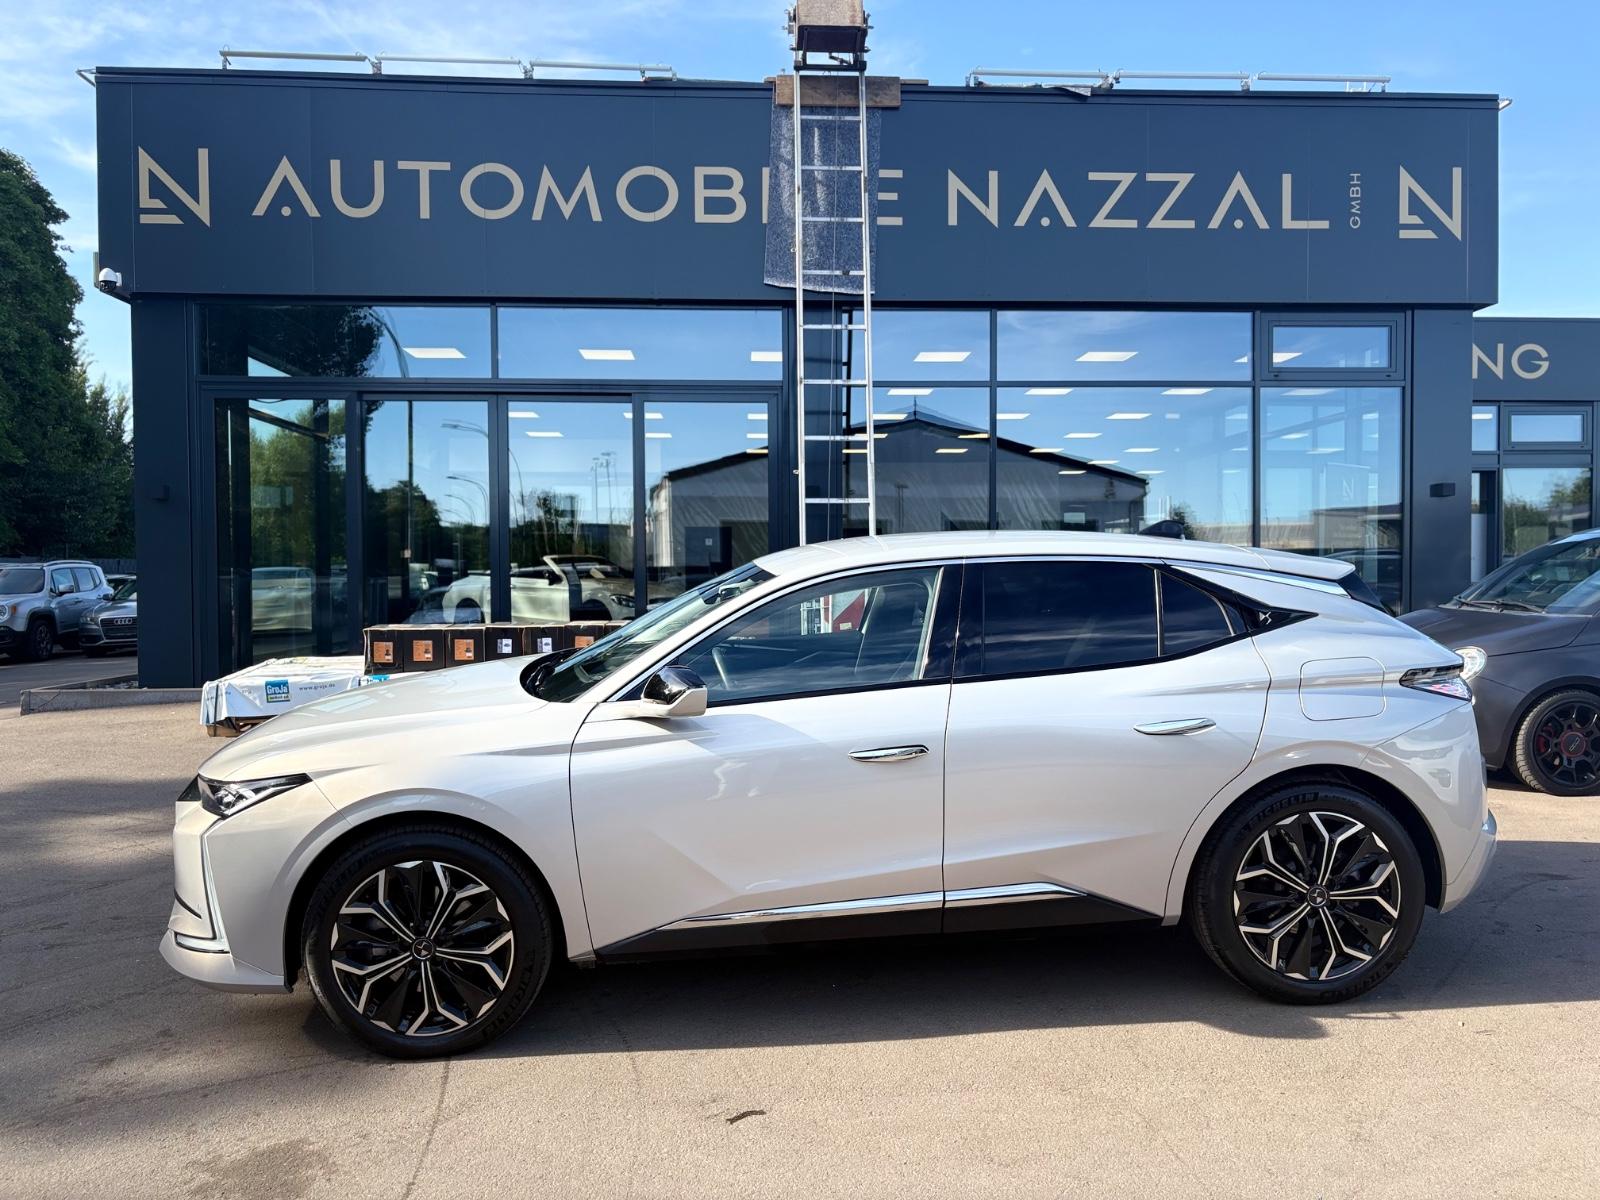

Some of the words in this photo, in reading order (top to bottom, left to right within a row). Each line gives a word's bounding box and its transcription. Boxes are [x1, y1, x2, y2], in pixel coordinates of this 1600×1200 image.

[252, 156, 903, 226] AUTOMOBIE
[948, 169, 1330, 230] NAZZAL
[1349, 173, 1361, 229] GMBH
[1472, 343, 1550, 380] NG
